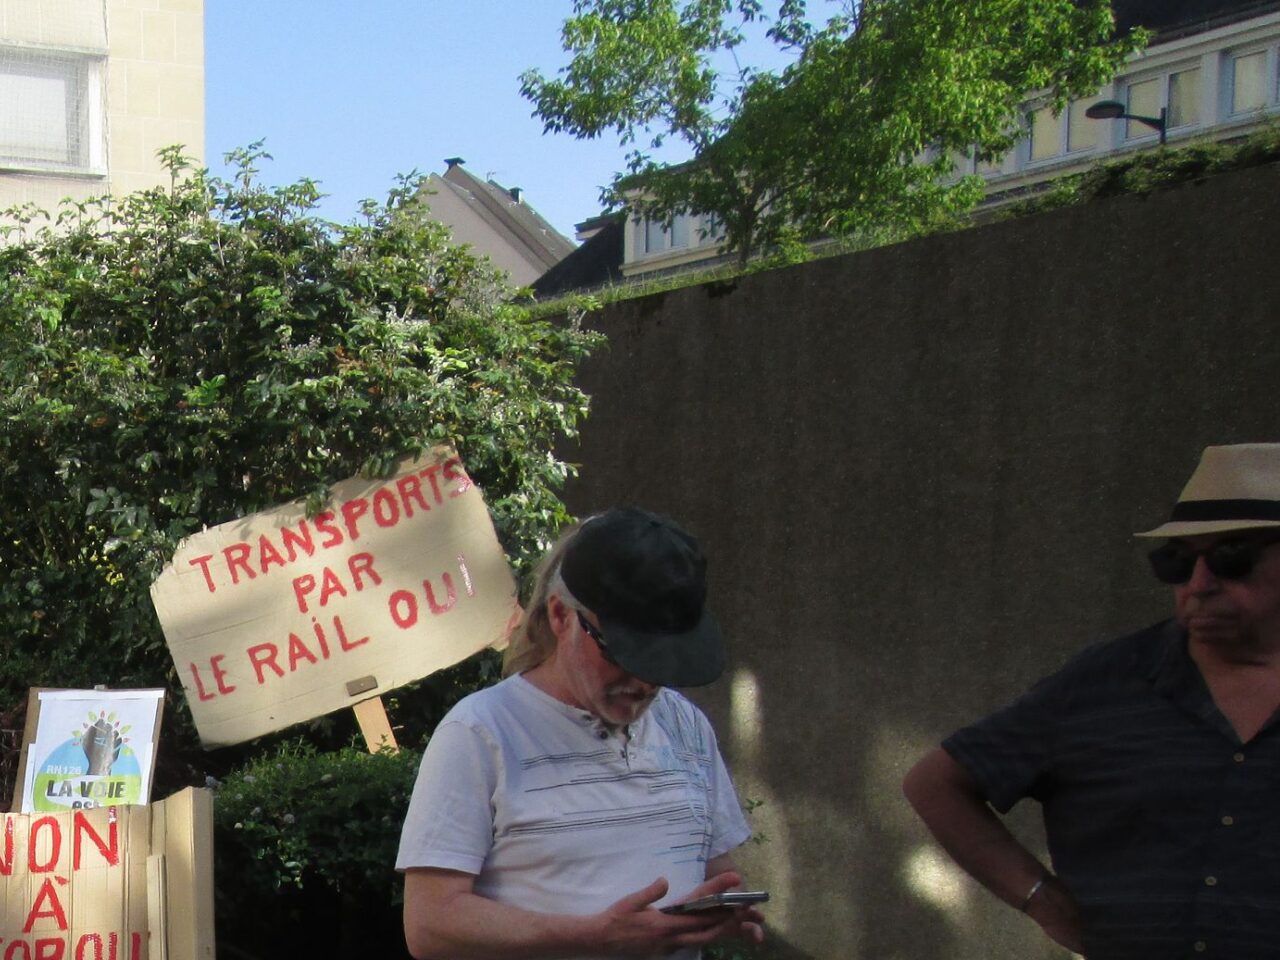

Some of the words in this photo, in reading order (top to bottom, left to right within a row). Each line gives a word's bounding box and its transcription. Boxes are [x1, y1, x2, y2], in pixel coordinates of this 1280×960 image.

[189, 458, 474, 593] TRANSPORTS
[292, 552, 382, 613] PAR
[191, 654, 236, 702] LE
[247, 616, 370, 684] RAIL
[389, 553, 476, 629] OUI
[46, 780, 72, 798] LA
[80, 781, 125, 799] VOIE
[24, 876, 70, 934] À
